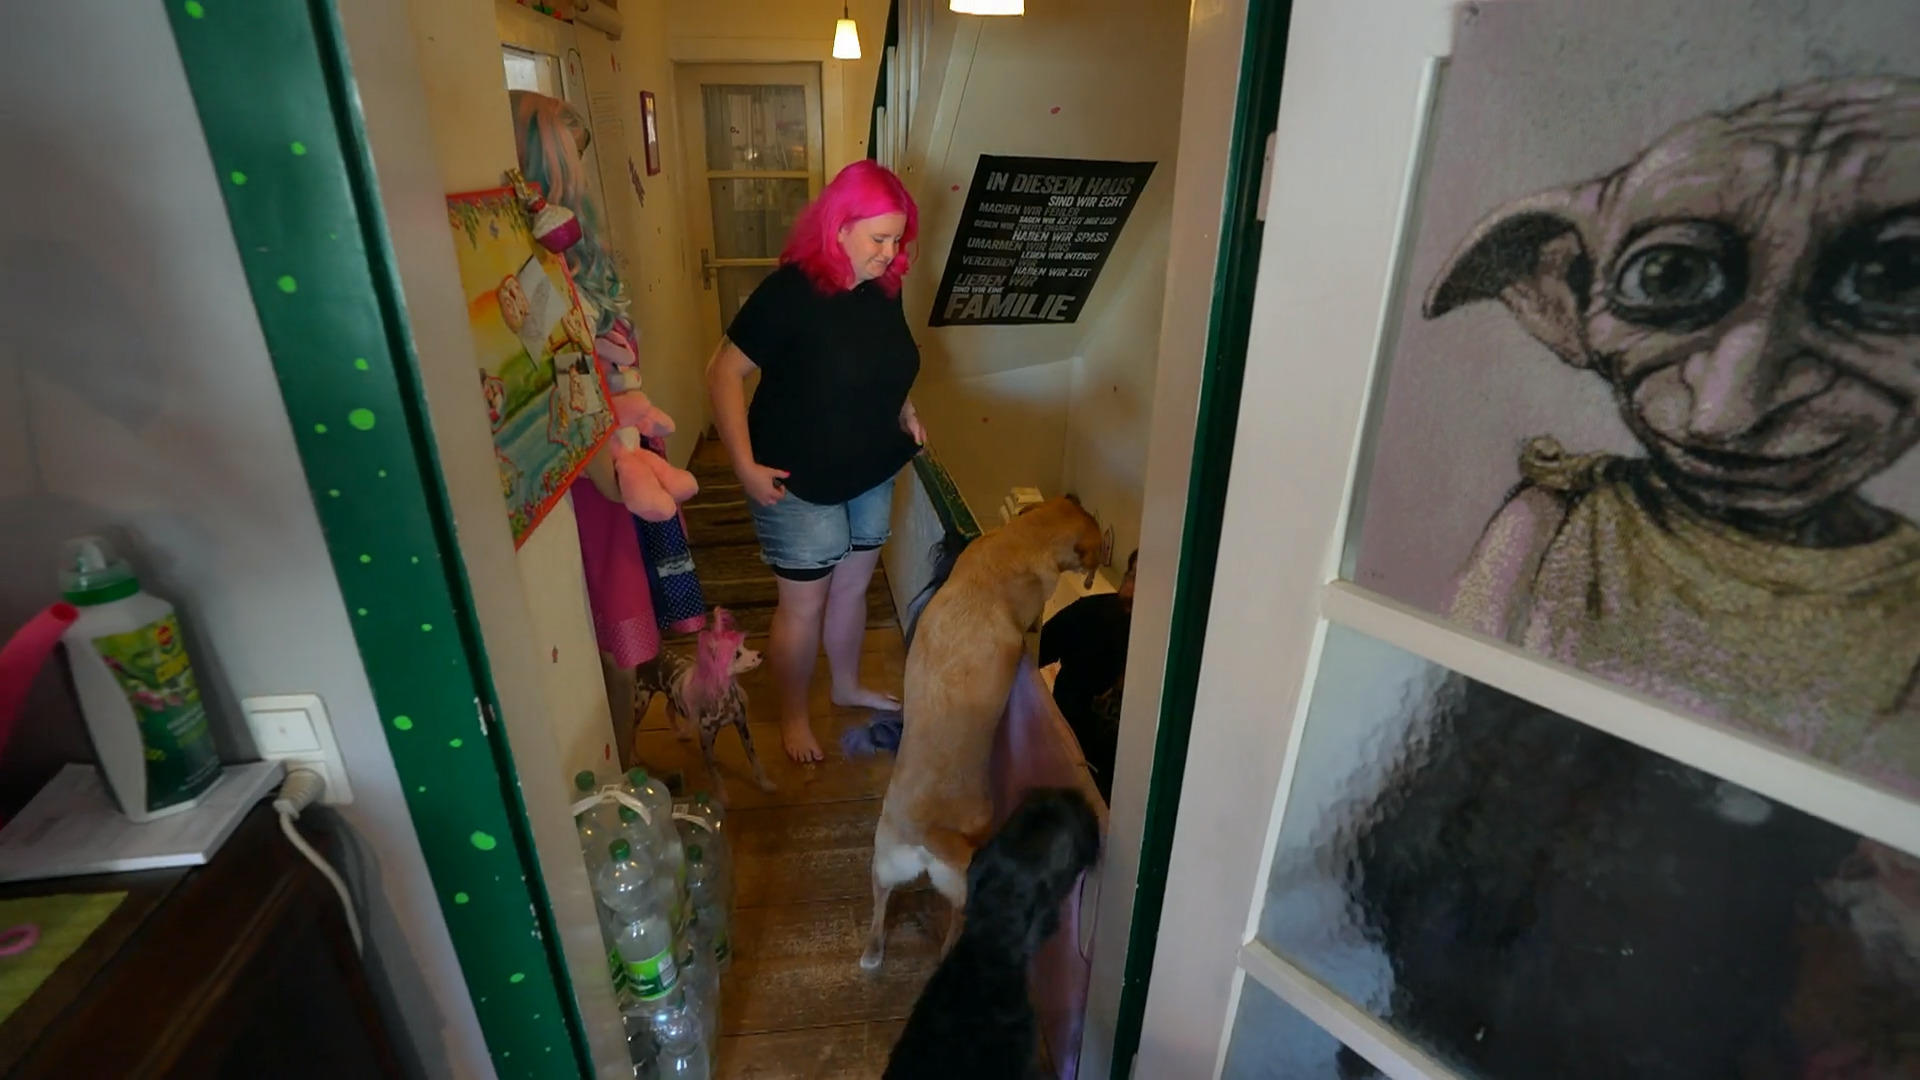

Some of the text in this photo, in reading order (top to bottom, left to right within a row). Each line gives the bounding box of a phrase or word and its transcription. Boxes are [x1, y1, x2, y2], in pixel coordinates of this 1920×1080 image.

[986, 171, 1135, 195] IN DIESEM HAUS
[1048, 195, 1128, 208] SIND WIR ECHT
[978, 202, 1080, 217] MACHEN WIR FEHLER
[1012, 230, 1109, 243] HABEN WIR SPASS
[967, 237, 1023, 251] UMARMEN
[1025, 241, 1047, 252] WIR
[1013, 266, 1092, 277] HABEN WIR ZEIT
[955, 273, 1039, 287] LIEBEN WIR
[943, 292, 1076, 320] FAMILIE
